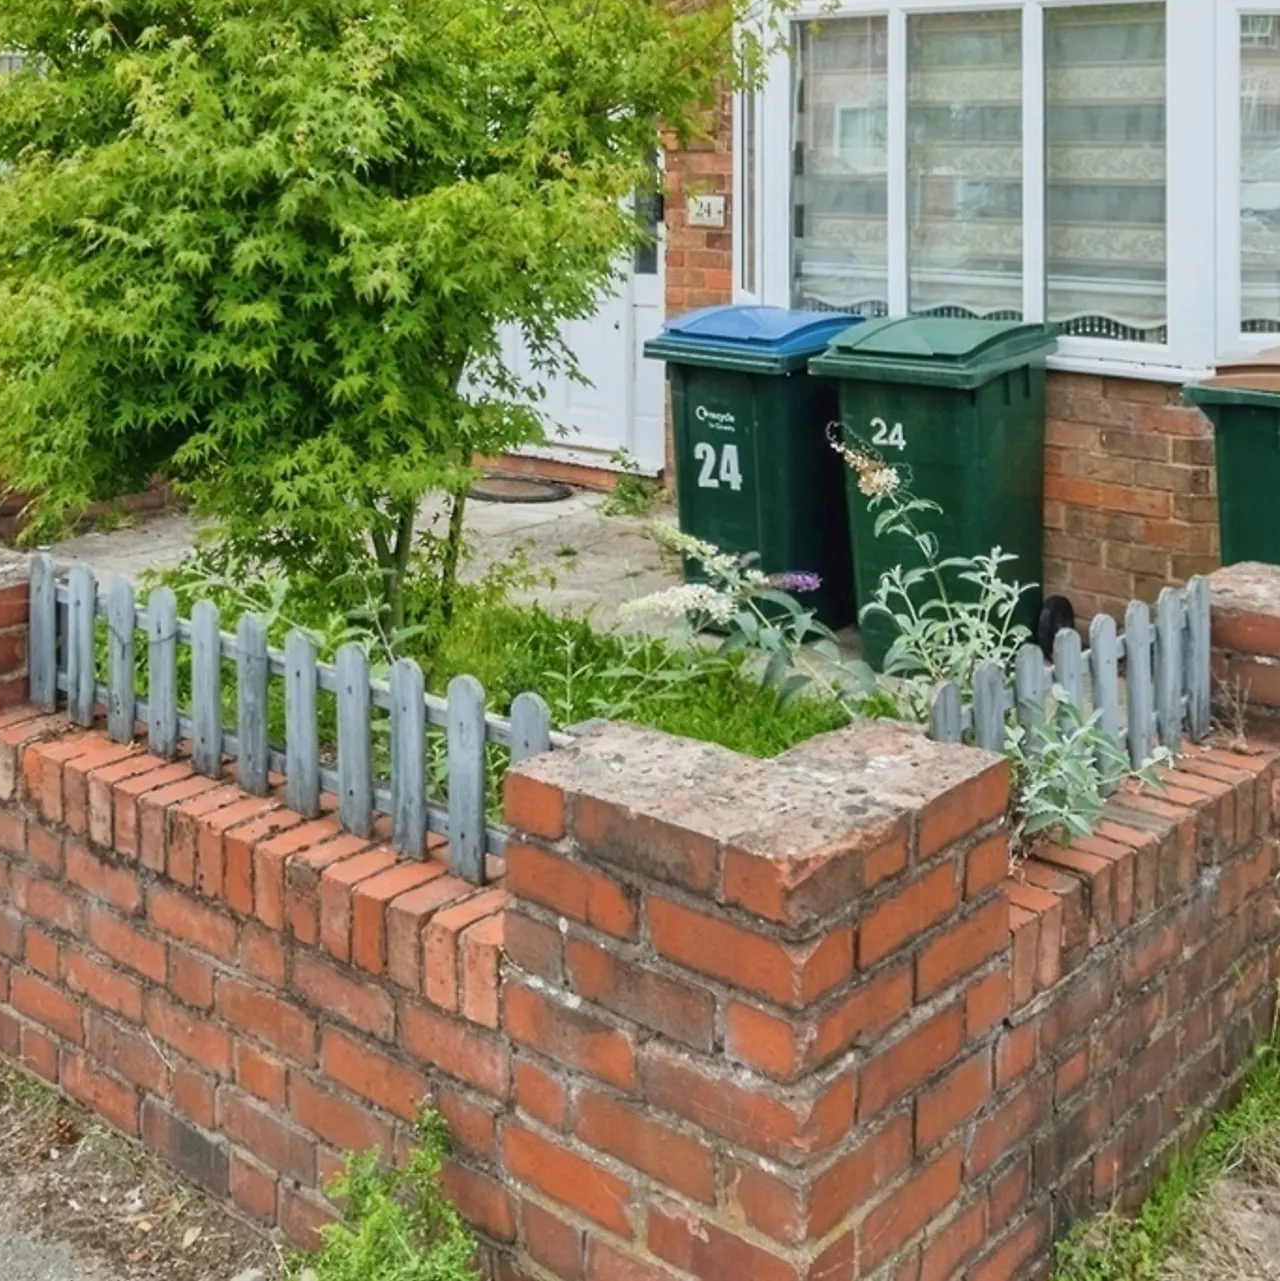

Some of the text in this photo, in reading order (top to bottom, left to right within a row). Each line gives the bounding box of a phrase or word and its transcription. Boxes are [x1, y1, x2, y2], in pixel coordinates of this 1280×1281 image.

[696, 201, 711, 218] 24
[870, 417, 907, 451] 24
[694, 442, 743, 491] 24
